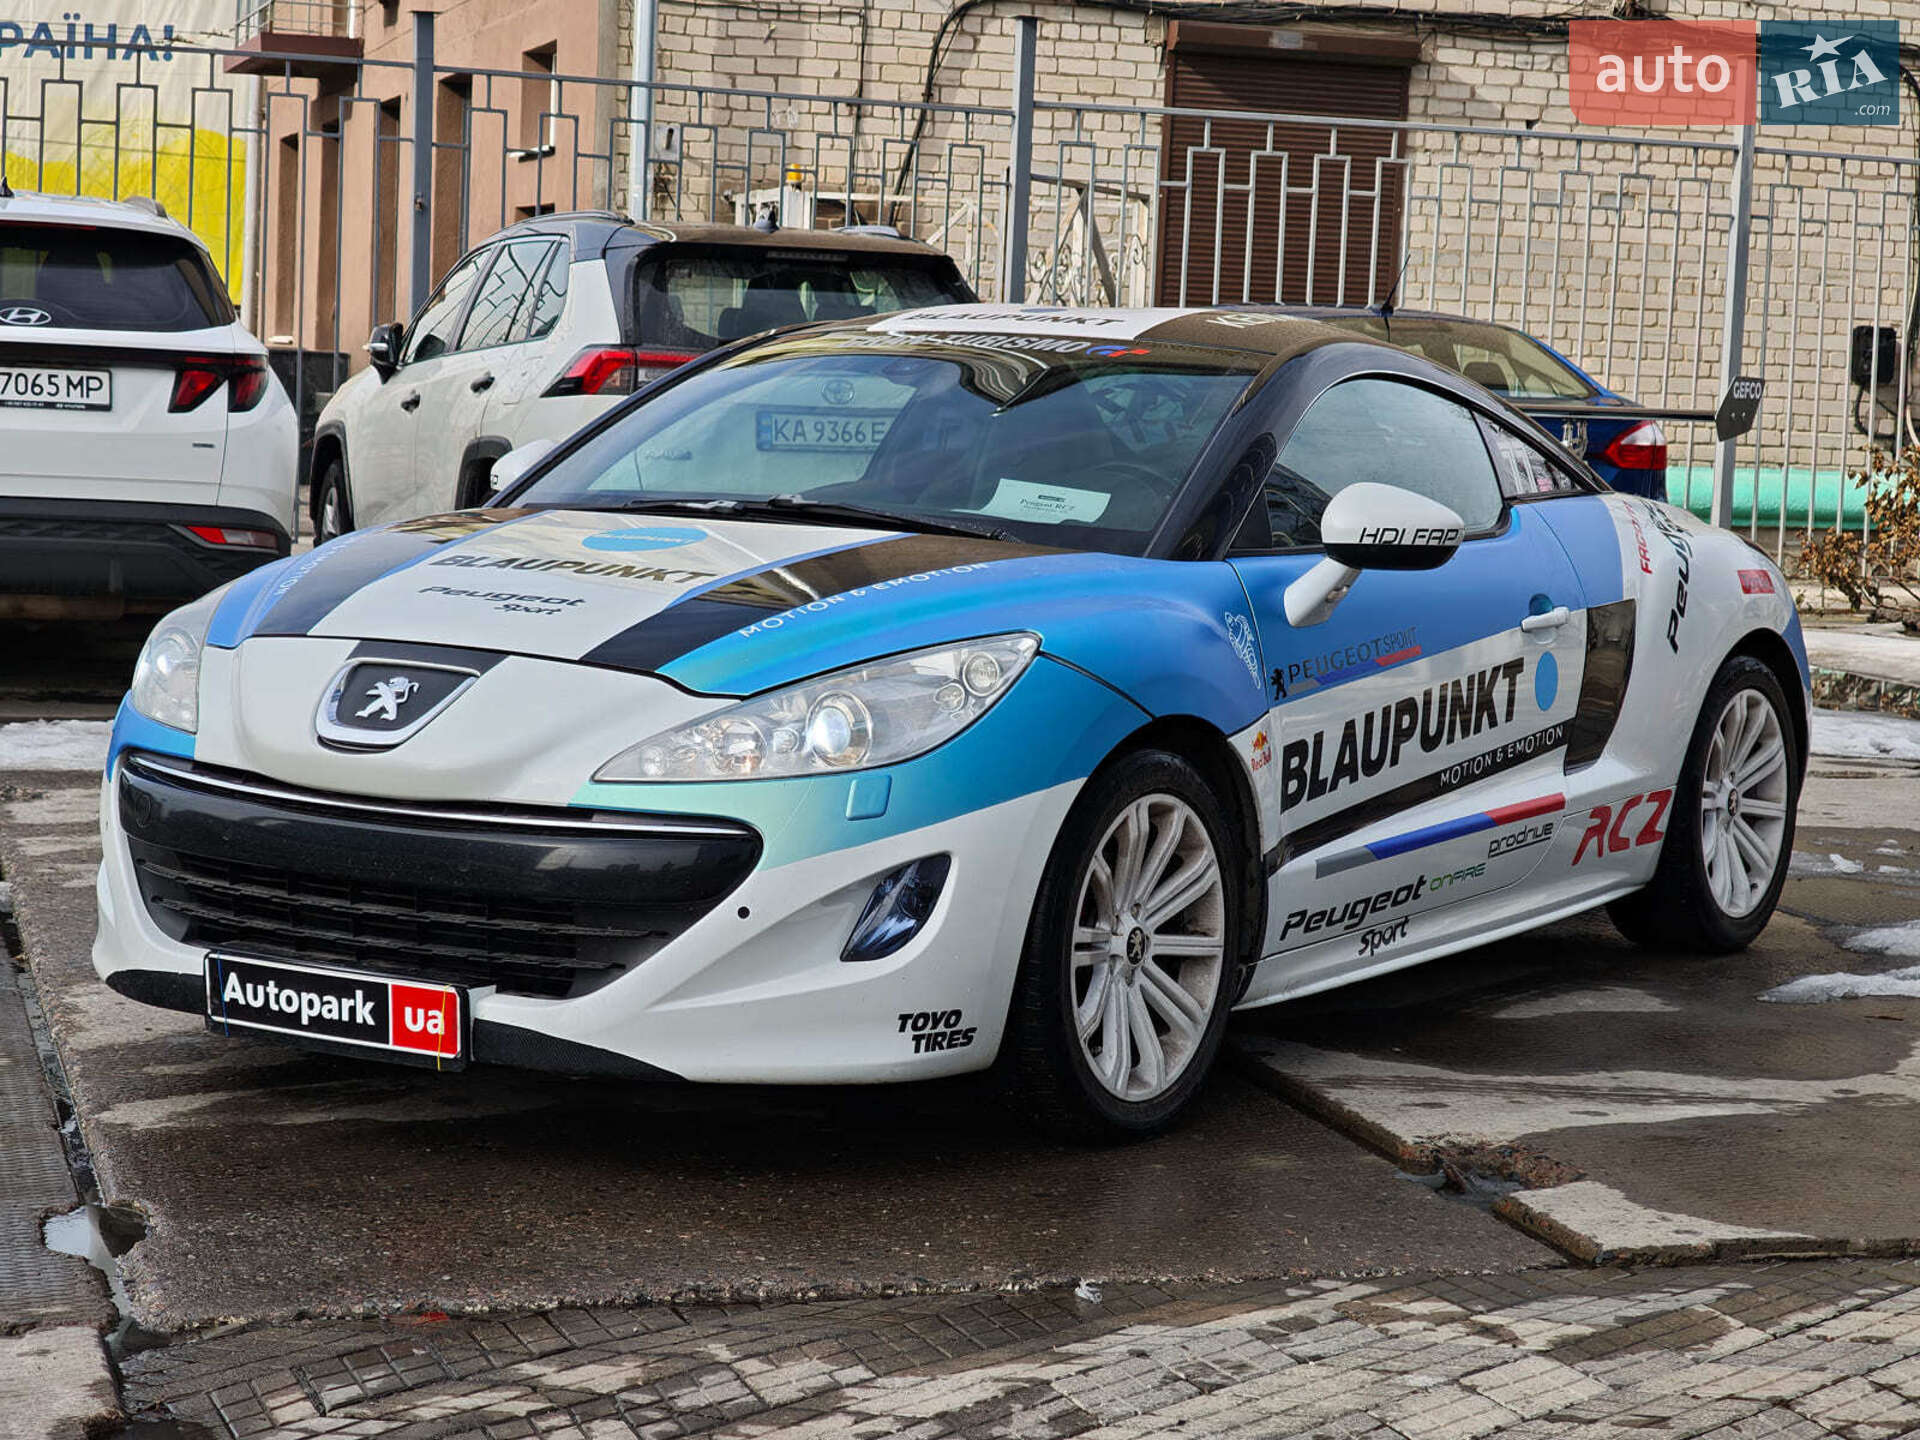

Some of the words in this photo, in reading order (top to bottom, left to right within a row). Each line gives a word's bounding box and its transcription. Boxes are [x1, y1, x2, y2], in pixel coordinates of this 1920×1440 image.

[904, 313, 1125, 326] BLAUPUNKT
[0, 372, 60, 397] 7065
[66, 375, 103, 399] MP
[1733, 382, 1762, 399] GEFCO
[774, 419, 807, 443] KA
[814, 420, 867, 443] 9366
[1359, 527, 1406, 546] HDI
[1411, 528, 1460, 546] FAP
[430, 555, 718, 583] BLAUPUNKT
[418, 586, 587, 606] Peugeot
[739, 595, 846, 638] MOTION
[852, 588, 866, 597] &
[872, 562, 989, 591] EMOTION
[1280, 657, 1524, 815] BLAUPUNKT
[1440, 752, 1493, 787] MOTION
[1507, 724, 1564, 759] EMOTION
[1571, 788, 1674, 867] RCZ
[1279, 874, 1428, 941] Peugeot
[223, 971, 376, 1027] Autopark
[404, 1006, 445, 1035] ua
[897, 1008, 963, 1033] TOYO
[911, 1026, 978, 1054] TIRES
